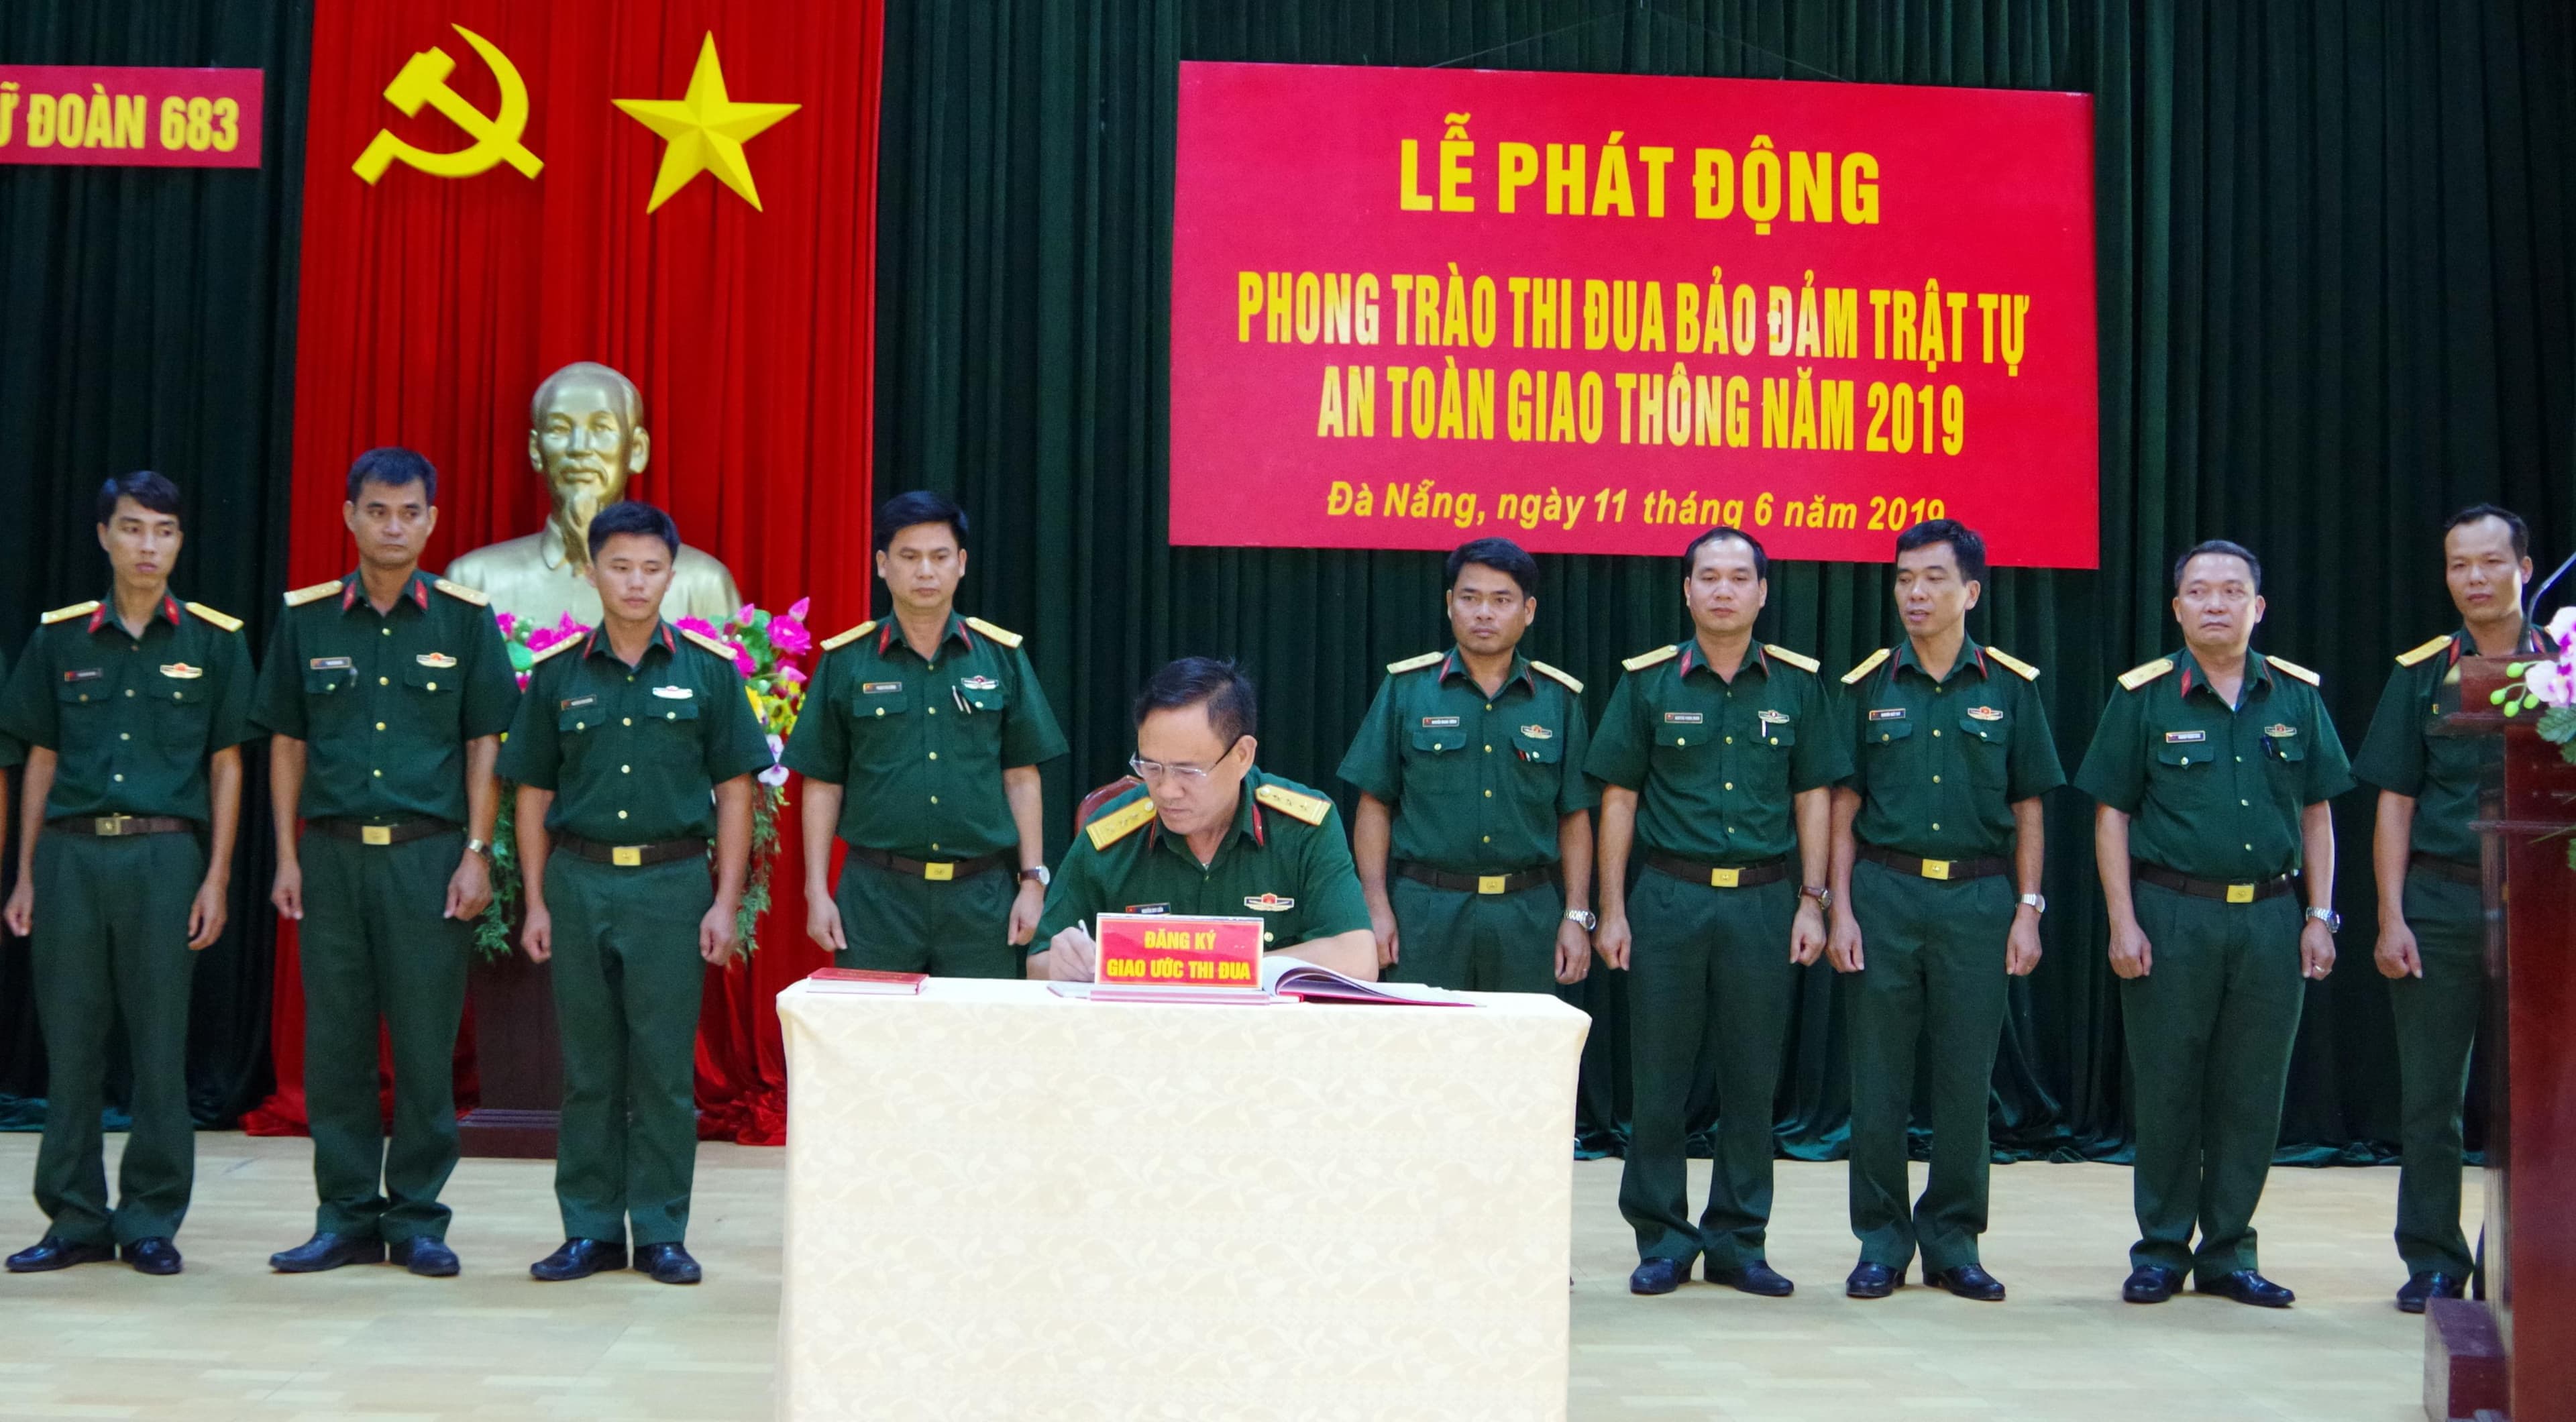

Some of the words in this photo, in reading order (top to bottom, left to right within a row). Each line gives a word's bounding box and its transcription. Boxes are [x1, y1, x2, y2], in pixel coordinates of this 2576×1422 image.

[27, 83, 147, 149] ĐOÀN
[160, 97, 238, 151] 683
[1401, 113, 1474, 212] LỄ
[1499, 131, 1674, 217] PHÁT
[1693, 135, 1878, 235] ĐỘNG
[1238, 272, 1379, 345] PHONG
[1391, 262, 1496, 347] TRÀO
[1509, 277, 1571, 349] THI
[1583, 279, 1666, 351] ĐUA
[1676, 266, 1756, 356] BẢO
[1767, 270, 1857, 358] ĐẢM
[1870, 278, 1967, 372] TRẬT
[1978, 294, 2029, 376] TỰ
[1318, 366, 1375, 437] AN
[1387, 356, 1495, 440] TOÀN
[1507, 369, 1603, 443] GIAO
[1615, 362, 1750, 447] THÔNG
[1762, 366, 1854, 450] NĂM
[1866, 382, 1964, 455] 2019
[1328, 481, 1373, 516] Đà
[1383, 479, 1485, 528] Nẵng,
[1497, 487, 1585, 530] ngày
[1595, 488, 1627, 522] 11
[1644, 490, 1743, 530] tháng
[1755, 492, 1774, 526] 6
[1784, 495, 1857, 529] năm
[1868, 496, 1944, 531] 2019
[1108, 959, 1146, 977] GIAO
[1150, 957, 1183, 978] ƯỚC
[1188, 961, 1214, 979] THI
[1218, 962, 1250, 979] ĐUA
[1144, 929, 1190, 950] ĐĂNG
[1195, 930, 1217, 950] KÝ
